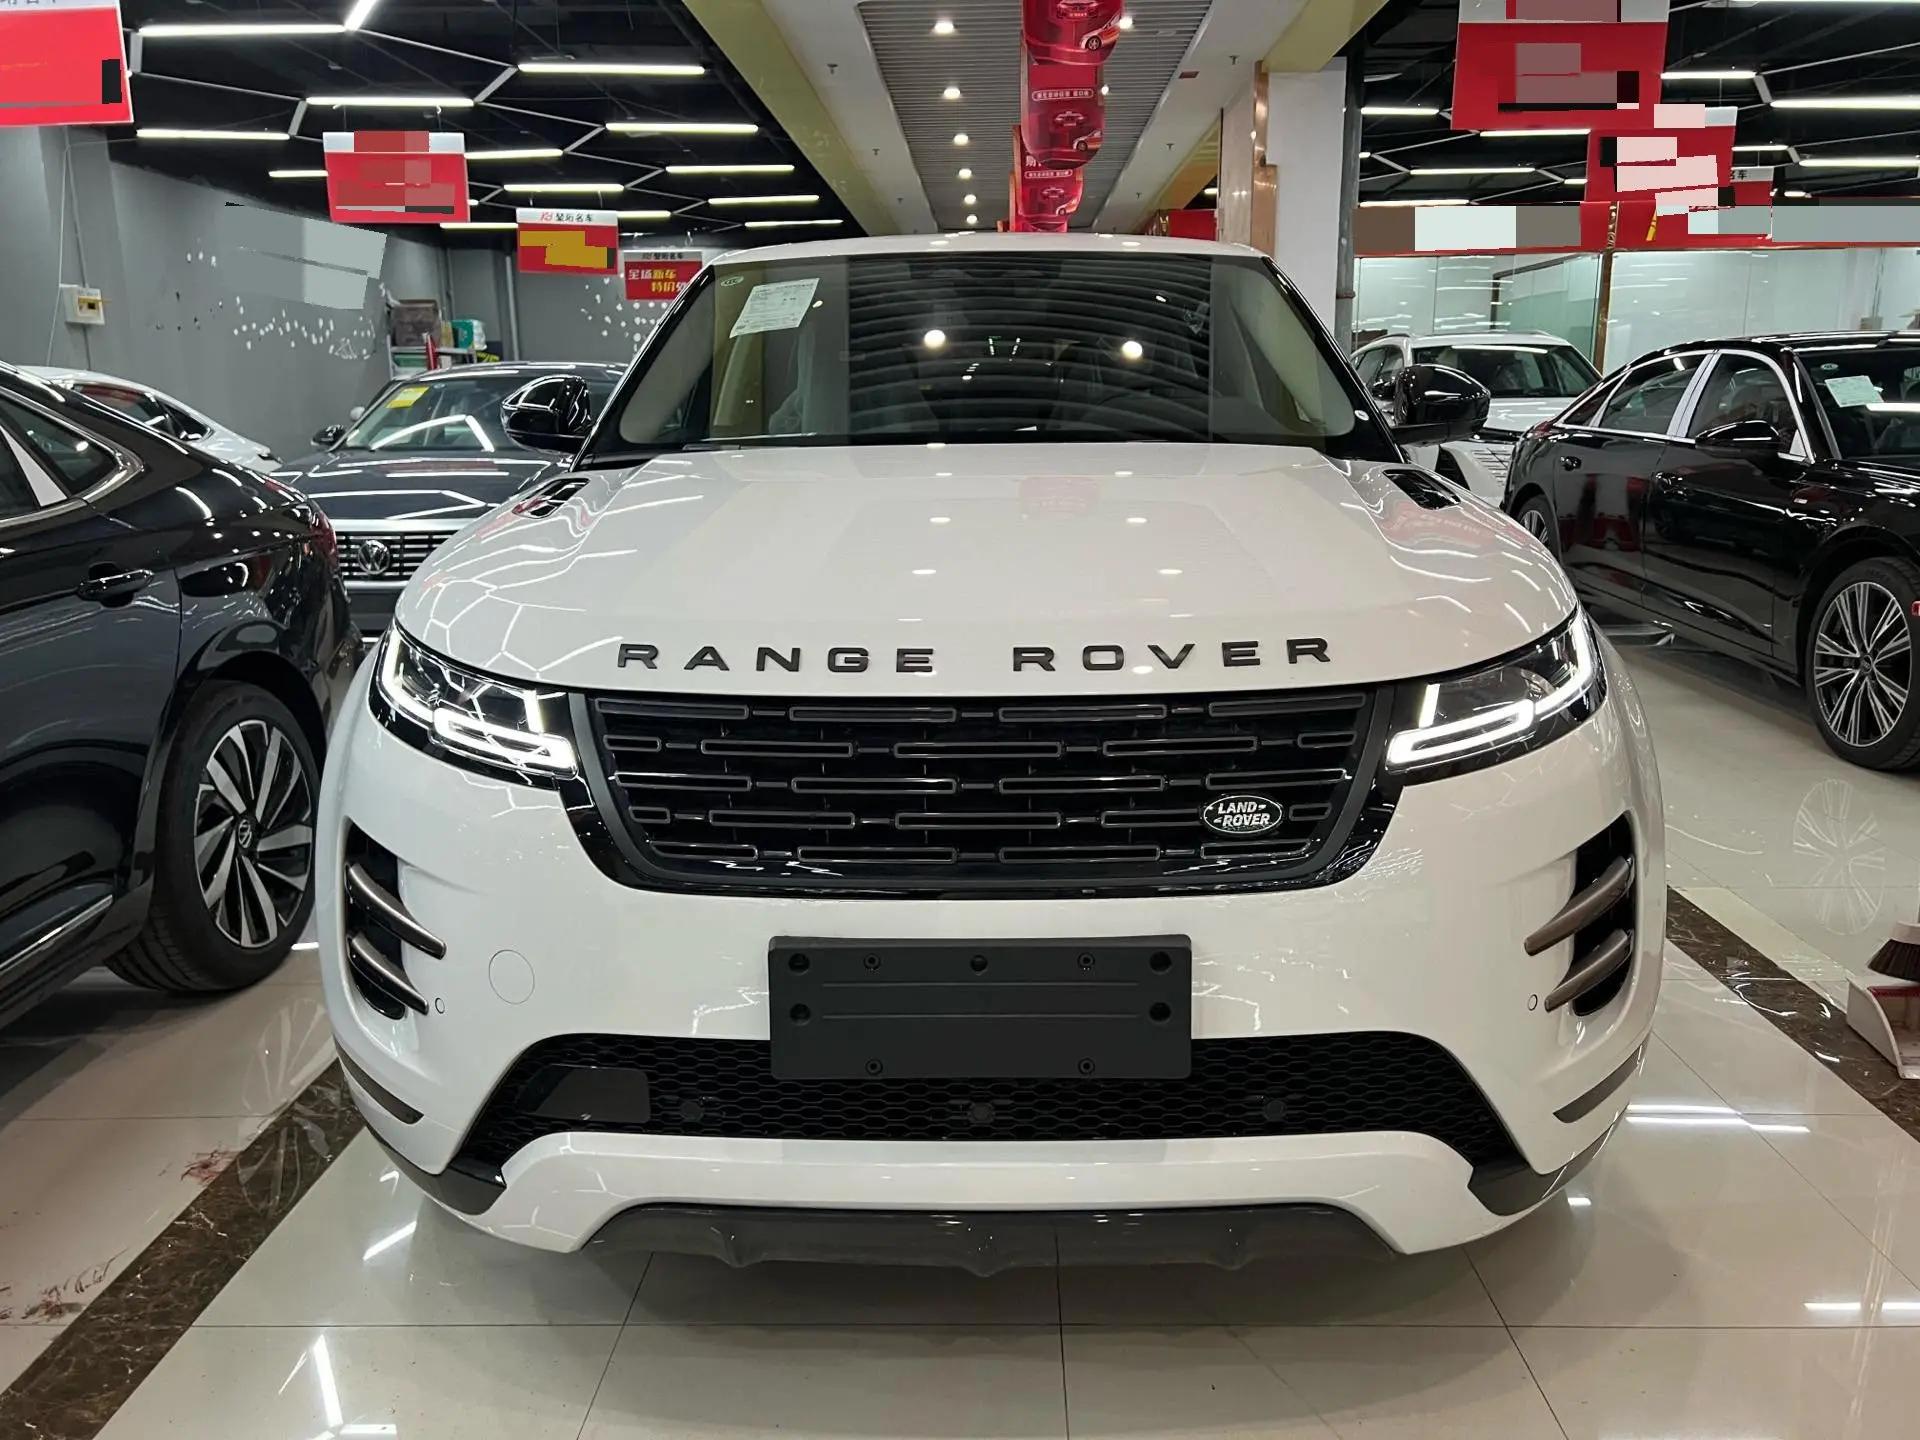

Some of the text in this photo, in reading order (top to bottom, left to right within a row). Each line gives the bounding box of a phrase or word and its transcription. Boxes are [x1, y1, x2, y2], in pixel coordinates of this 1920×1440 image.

[617, 637, 1331, 673] RANGE ROVER
[1217, 801, 1258, 815] LAND
[1222, 812, 1271, 828] ROVER
